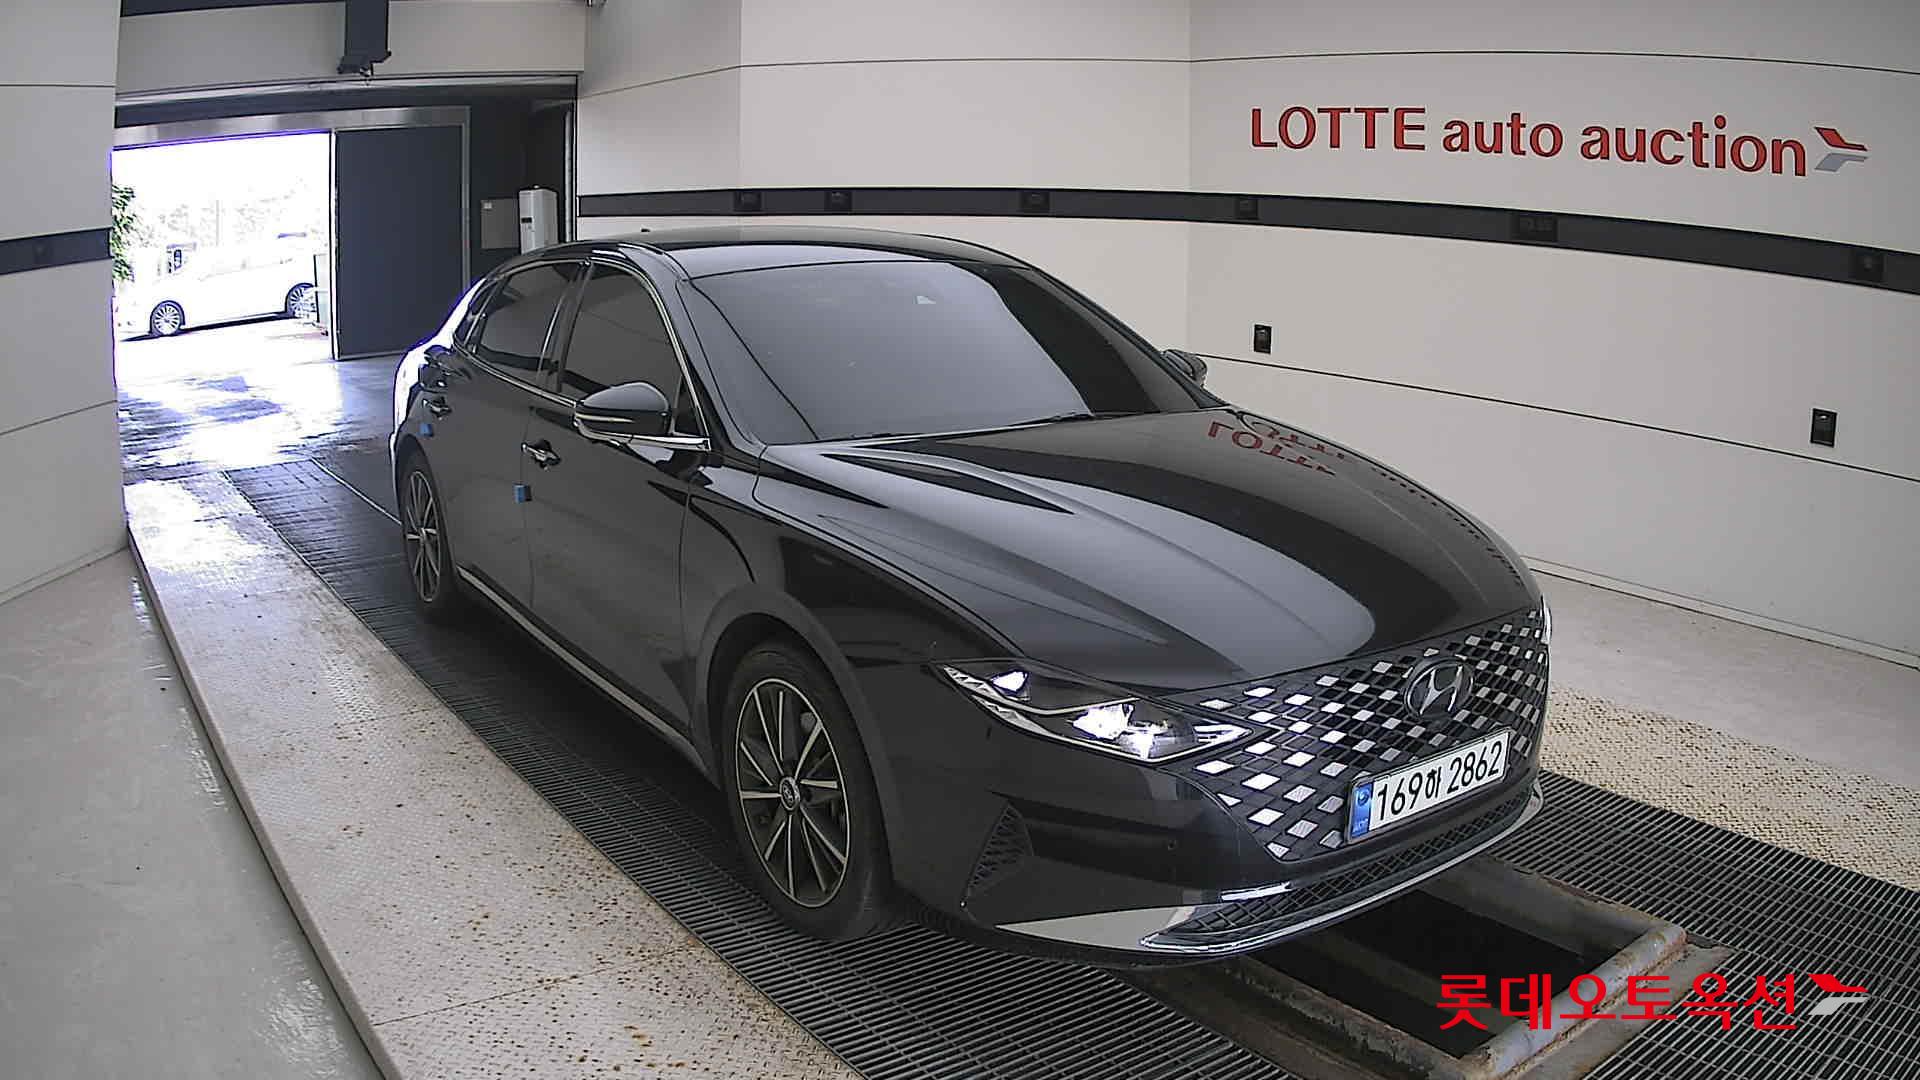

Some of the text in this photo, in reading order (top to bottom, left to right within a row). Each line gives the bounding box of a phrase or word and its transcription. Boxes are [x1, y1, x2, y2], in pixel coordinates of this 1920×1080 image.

[1251, 106, 1807, 176] LOTTE auto auction
[1377, 740, 1503, 821] 169하 2862
